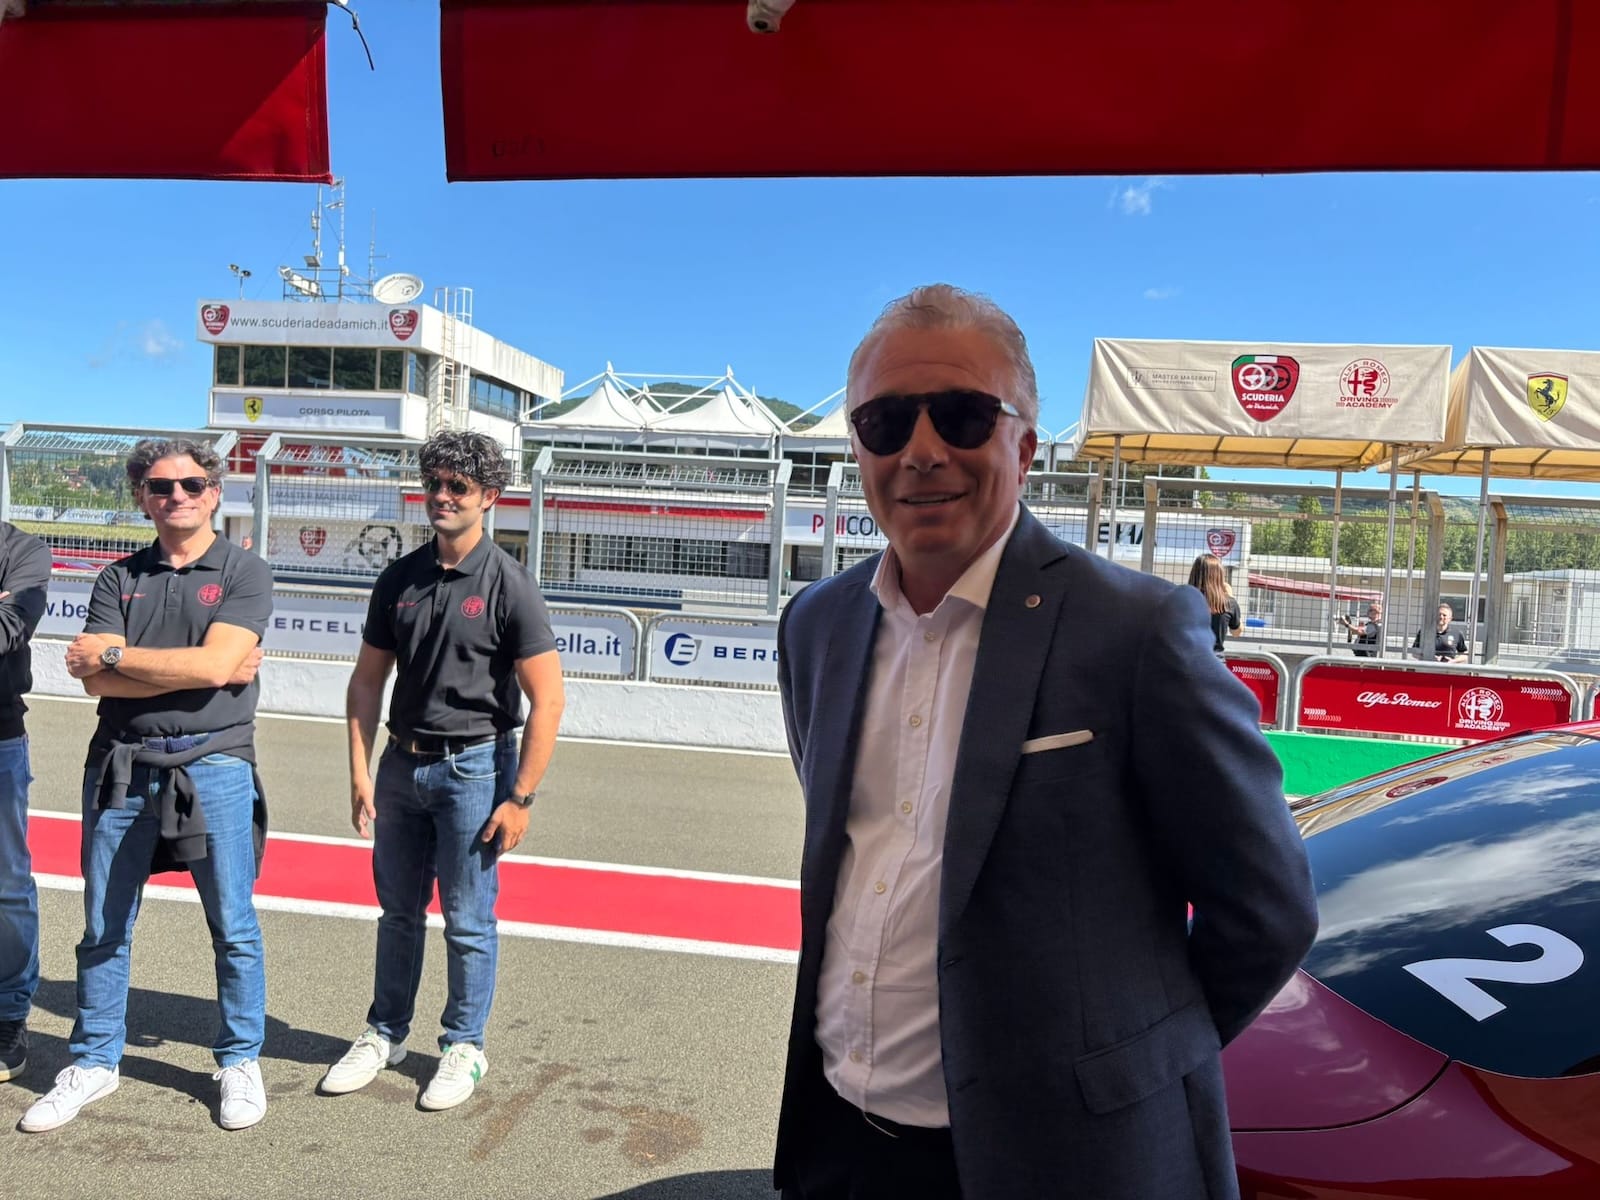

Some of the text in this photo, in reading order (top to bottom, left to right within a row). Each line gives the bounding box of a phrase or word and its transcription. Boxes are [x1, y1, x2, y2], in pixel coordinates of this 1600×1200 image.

[230, 316, 389, 331] www.scuderiadeadamich.it
[1362, 360, 1388, 384] ROMEO
[1241, 393, 1285, 402] SCUDERIA
[299, 407, 370, 417] CORSO PILOTA
[1356, 691, 1443, 709] Alfa Romeo
[1459, 718, 1494, 727] DRIVING
[1463, 724, 1506, 732] ACADEMY
[1402, 923, 1584, 1022] 2
